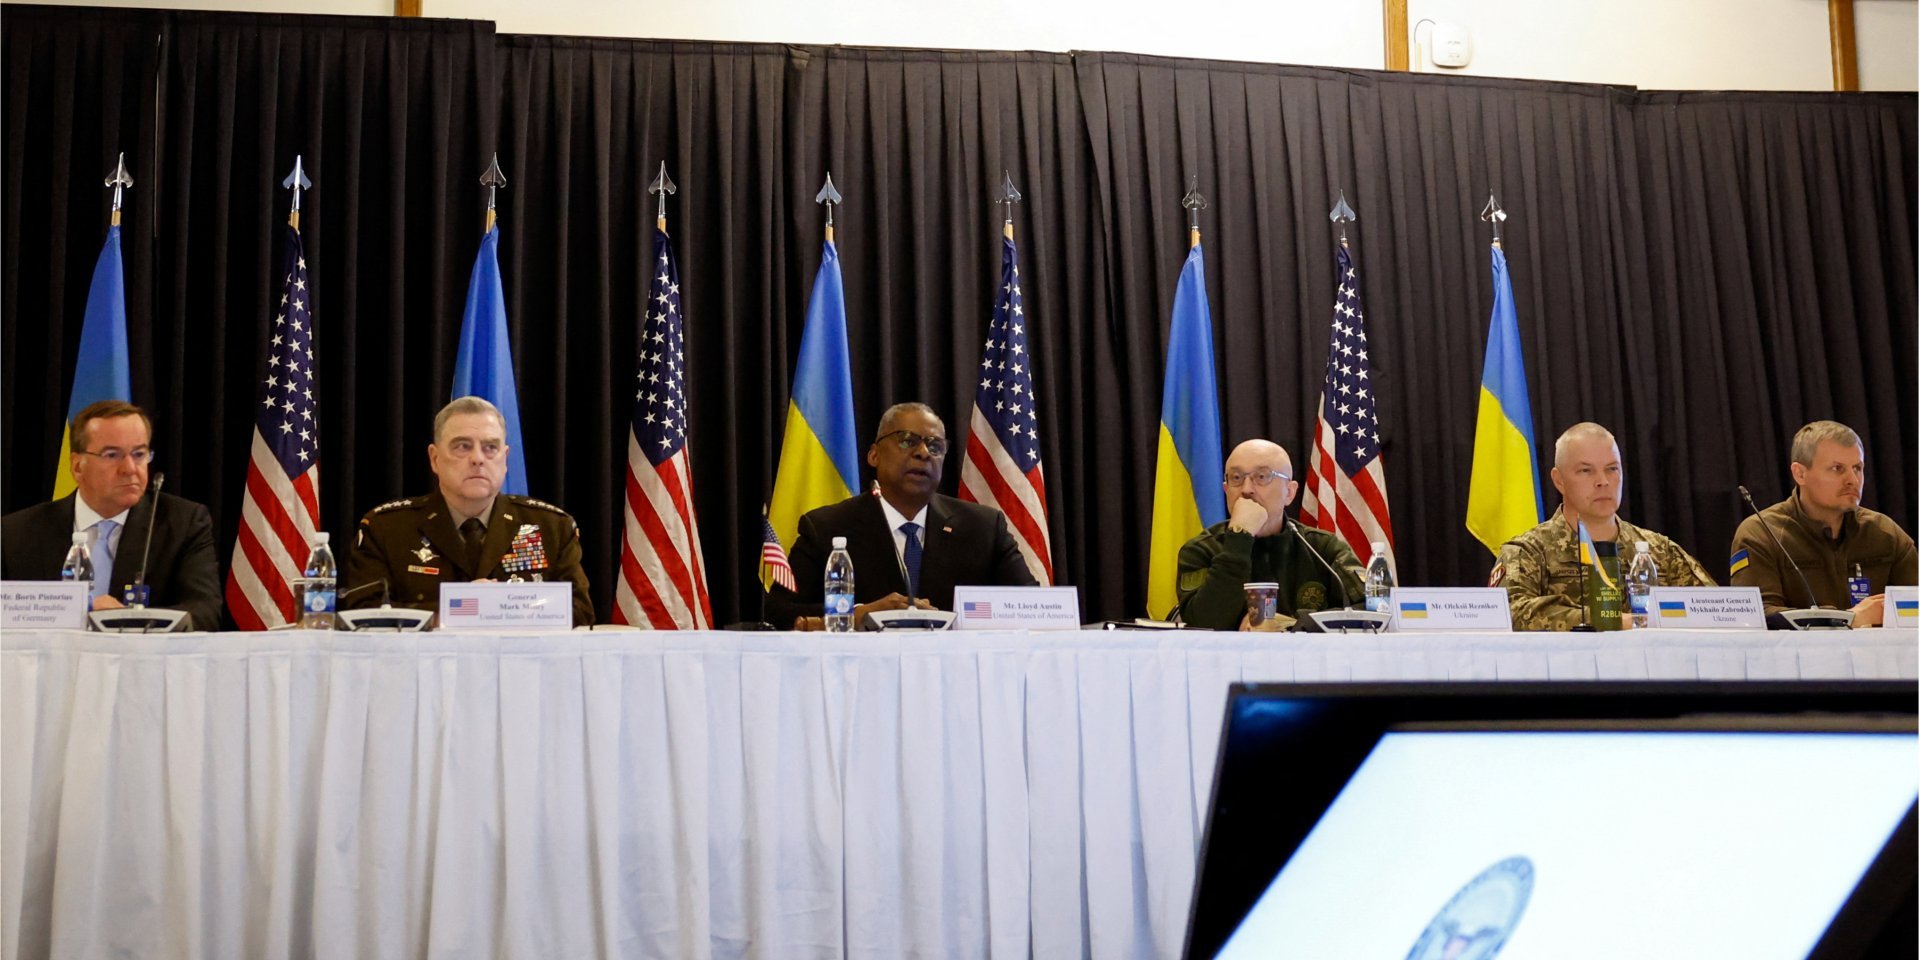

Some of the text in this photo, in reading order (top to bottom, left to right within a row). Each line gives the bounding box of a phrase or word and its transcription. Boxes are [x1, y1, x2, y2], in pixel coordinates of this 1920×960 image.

[15, 593, 36, 601] Boris
[38, 593, 73, 601] Pistorius
[3, 603, 66, 613] Federal Republic
[1018, 602, 1038, 611] Lloyd
[1039, 602, 1062, 610] Austin
[1689, 605, 1757, 614] Mykhailo Zabrodskyi
[12, 614, 57, 624] of Germany
